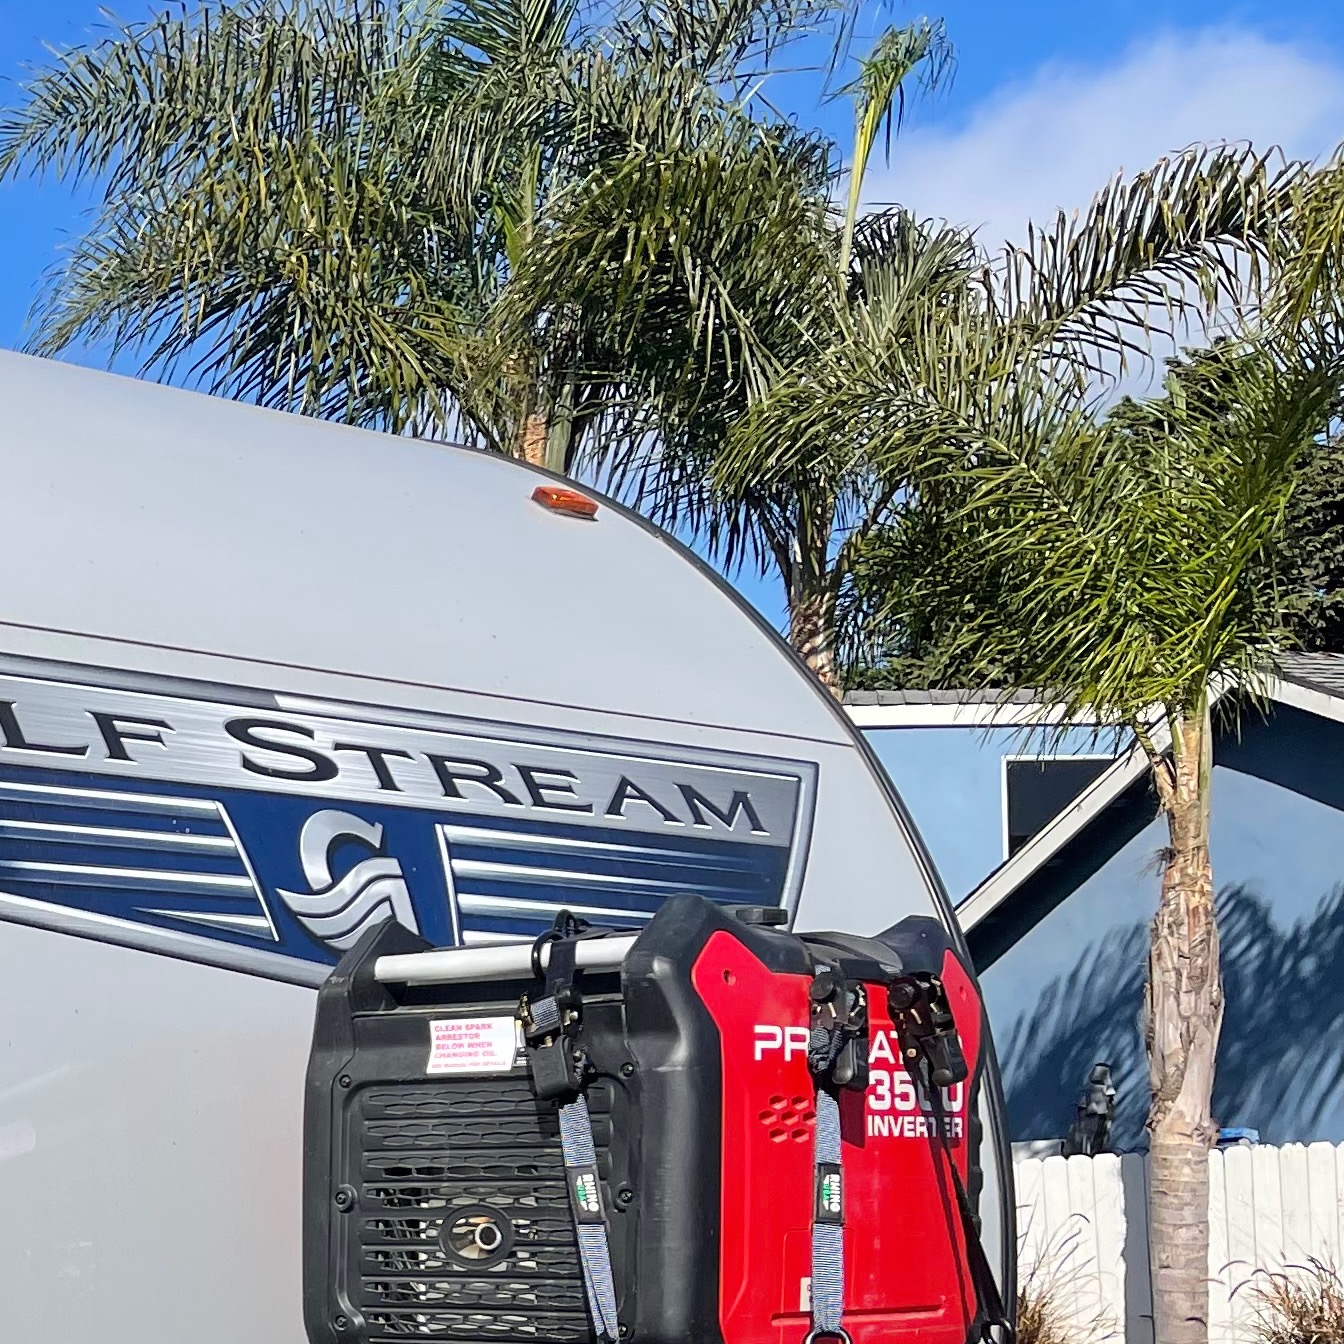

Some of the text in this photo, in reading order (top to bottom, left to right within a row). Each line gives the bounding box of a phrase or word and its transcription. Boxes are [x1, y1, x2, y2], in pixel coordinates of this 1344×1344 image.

[224, 717, 772, 836] STREAM
[434, 1022, 493, 1033] CLEAN SPARK
[435, 1043, 465, 1051] BELOW
[582, 1173, 600, 1211] RHINO
[829, 1173, 841, 1212] RHINO
